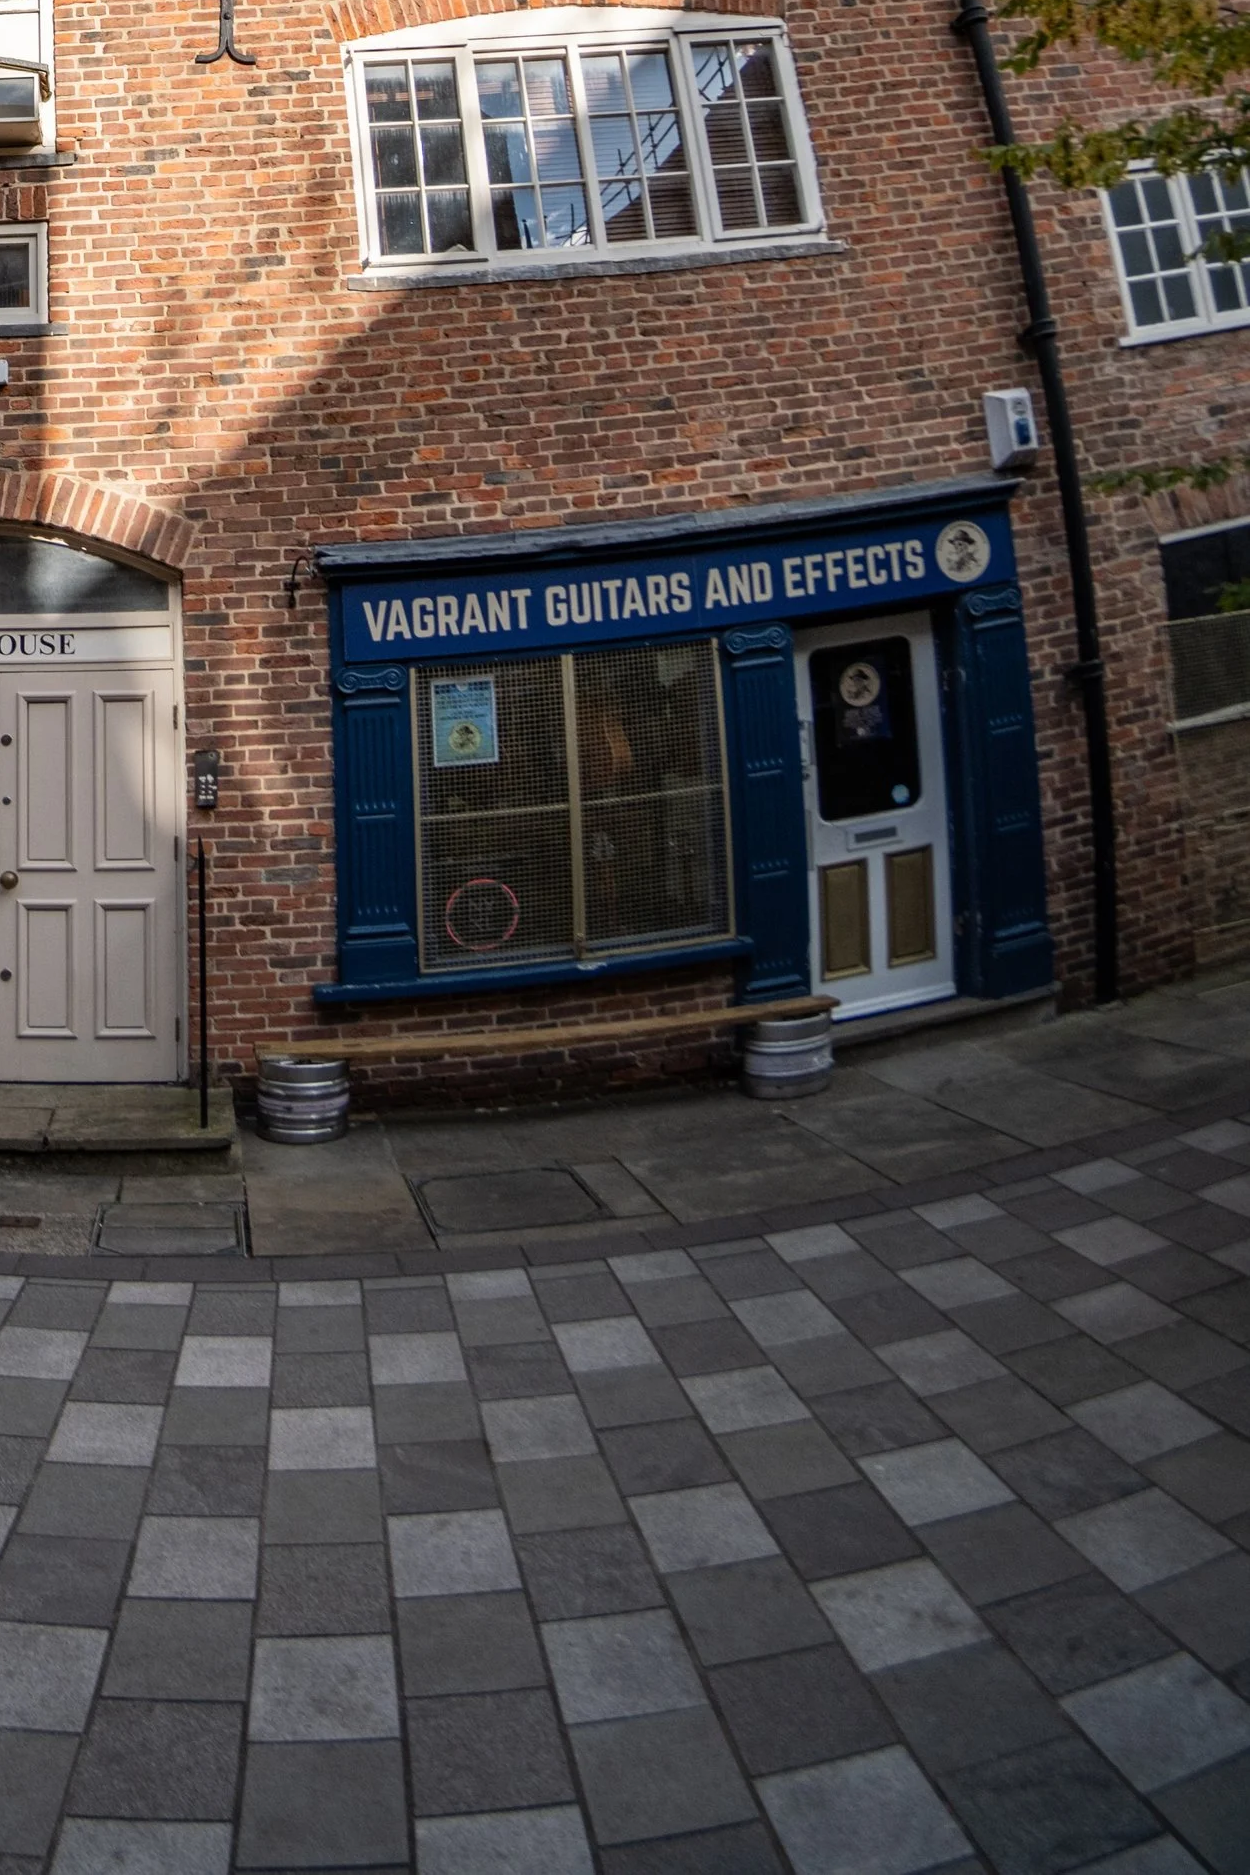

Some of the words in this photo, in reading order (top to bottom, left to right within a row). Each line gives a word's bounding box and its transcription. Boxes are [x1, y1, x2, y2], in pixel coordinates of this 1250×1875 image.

[362, 587, 532, 642] VAGRANT
[545, 571, 692, 626] GUITARS
[705, 562, 774, 610] AND
[784, 539, 925, 599] EFFECTS
